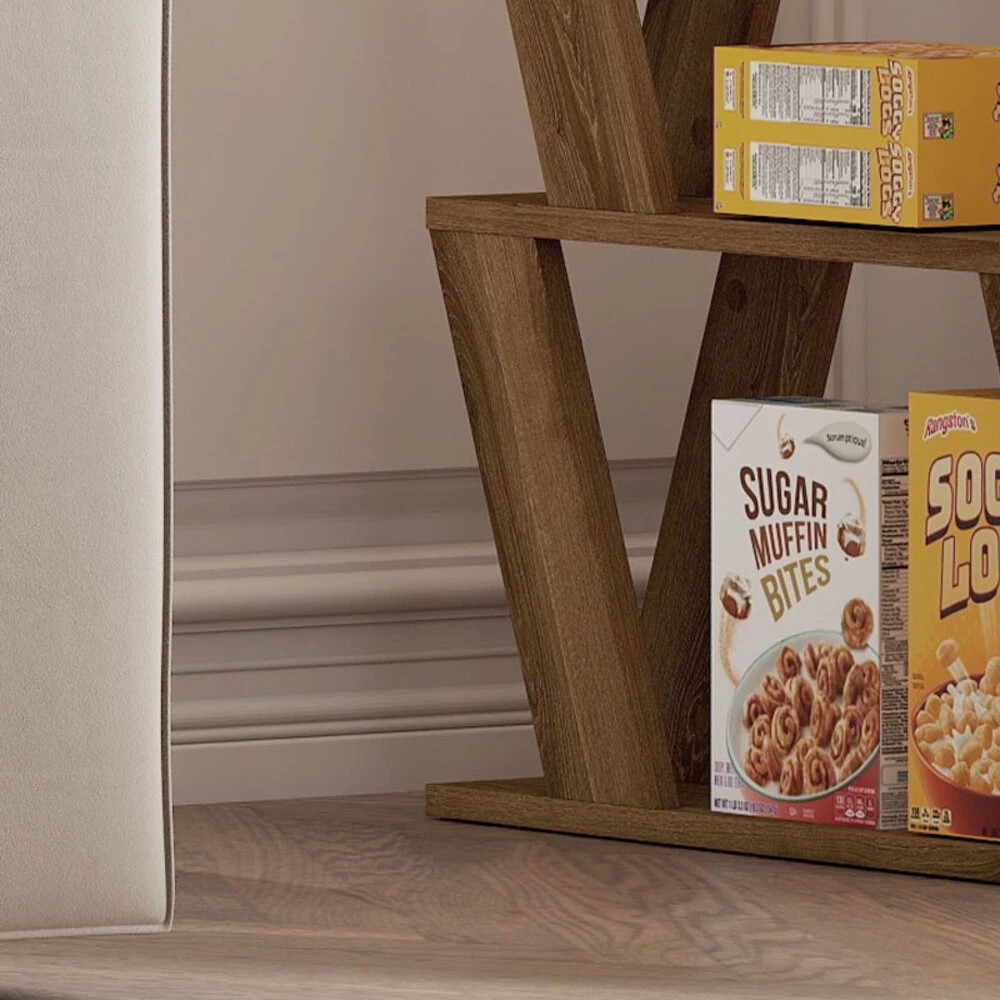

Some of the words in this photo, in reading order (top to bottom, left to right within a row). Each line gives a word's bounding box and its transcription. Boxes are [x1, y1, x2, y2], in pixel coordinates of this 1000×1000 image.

[876, 66, 892, 137] LOGS
[887, 59, 903, 141] SOGGY
[876, 147, 892, 219] LOGS
[887, 142, 903, 223] SOGGY
[739, 466, 828, 520] SUGAR
[749, 521, 828, 570] MUFFIN
[760, 554, 831, 622] BITES
